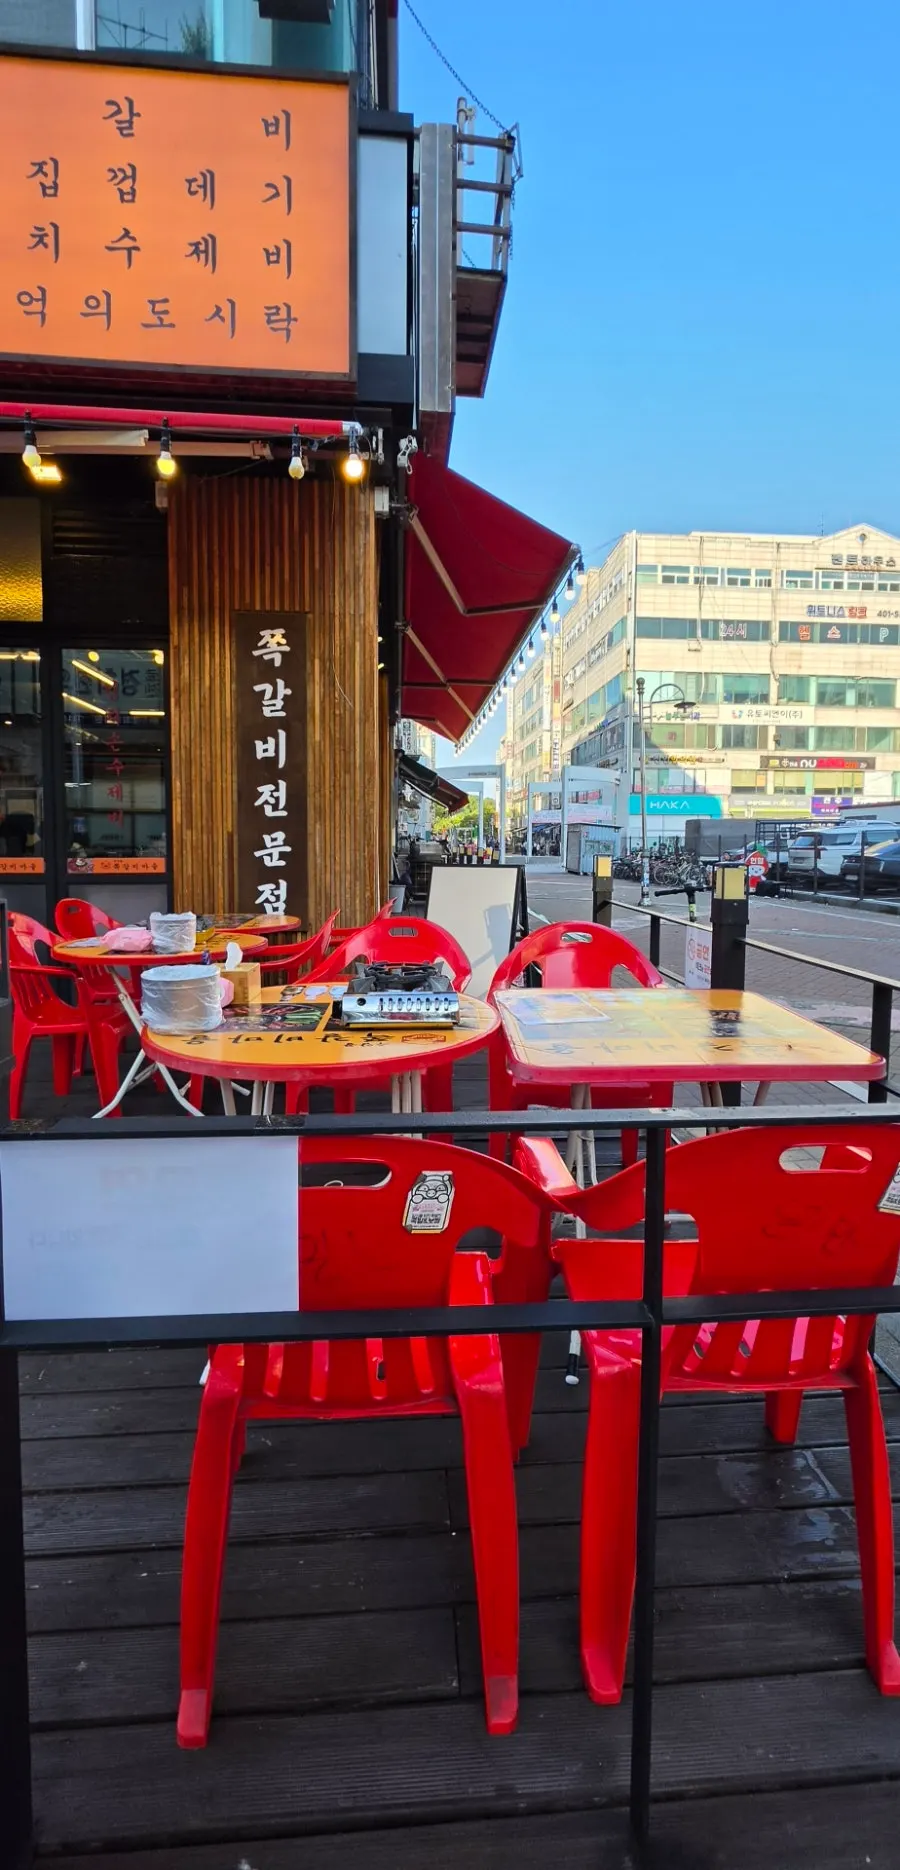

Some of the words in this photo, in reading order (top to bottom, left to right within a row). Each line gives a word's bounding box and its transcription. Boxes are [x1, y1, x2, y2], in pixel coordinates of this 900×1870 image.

[26, 157, 292, 216] 집껍데기
[27, 222, 292, 280] 치수제비
[251, 628, 293, 916] 쪽갈비전문점
[650, 801, 690, 810] HAKA
